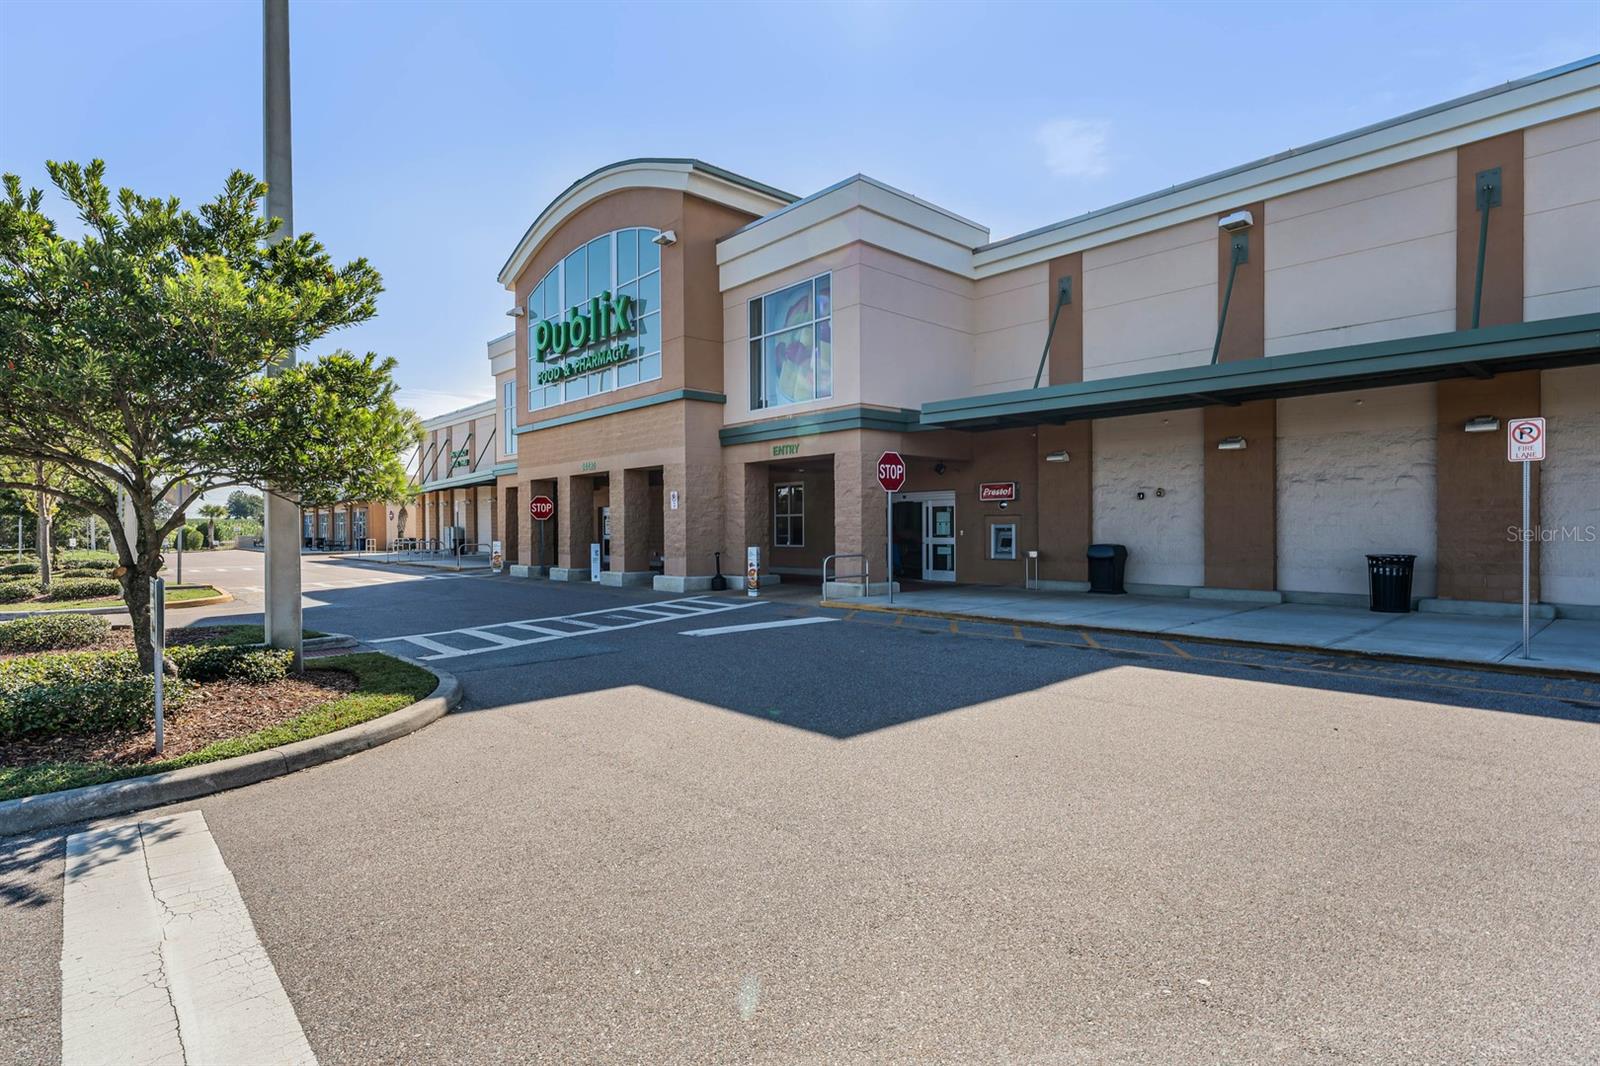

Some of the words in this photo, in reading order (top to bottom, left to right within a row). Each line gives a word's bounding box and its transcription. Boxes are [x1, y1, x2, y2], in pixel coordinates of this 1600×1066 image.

[538, 367, 562, 383] FOOD
[563, 364, 572, 376] &
[574, 344, 628, 372] PHARMACY
[773, 443, 800, 456] ENTRY
[879, 464, 903, 479] STOP
[983, 487, 1012, 498] Presto!
[531, 503, 552, 512] STOP
